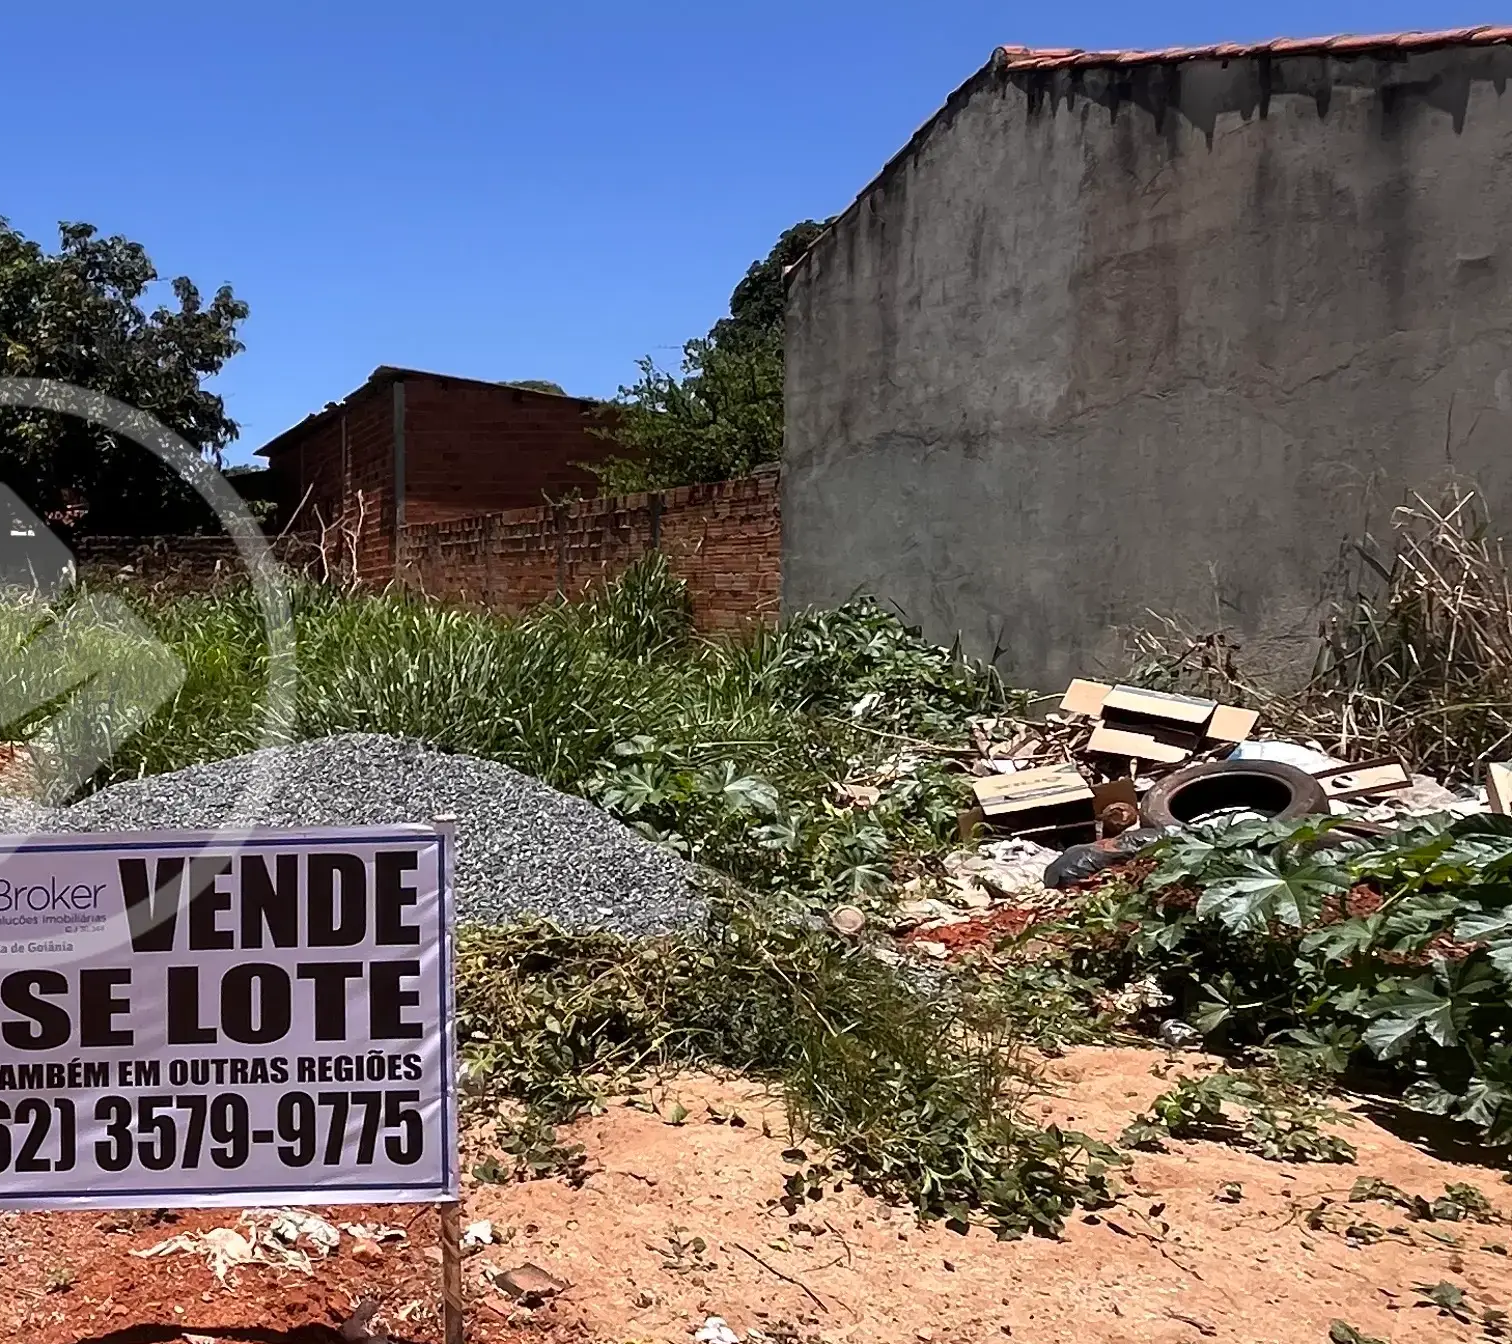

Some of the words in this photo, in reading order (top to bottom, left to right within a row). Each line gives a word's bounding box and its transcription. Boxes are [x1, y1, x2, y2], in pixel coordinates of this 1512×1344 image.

[118, 851, 420, 952] VENDE
[11, 942, 24, 954] de
[27, 940, 74, 954] Goiânia
[168, 960, 423, 1045] LOTE
[118, 1062, 161, 1087] EM
[169, 1057, 291, 1086] OUTRAS
[297, 1050, 423, 1082] REGIÕES
[94, 1090, 424, 1171] 3579-9775
